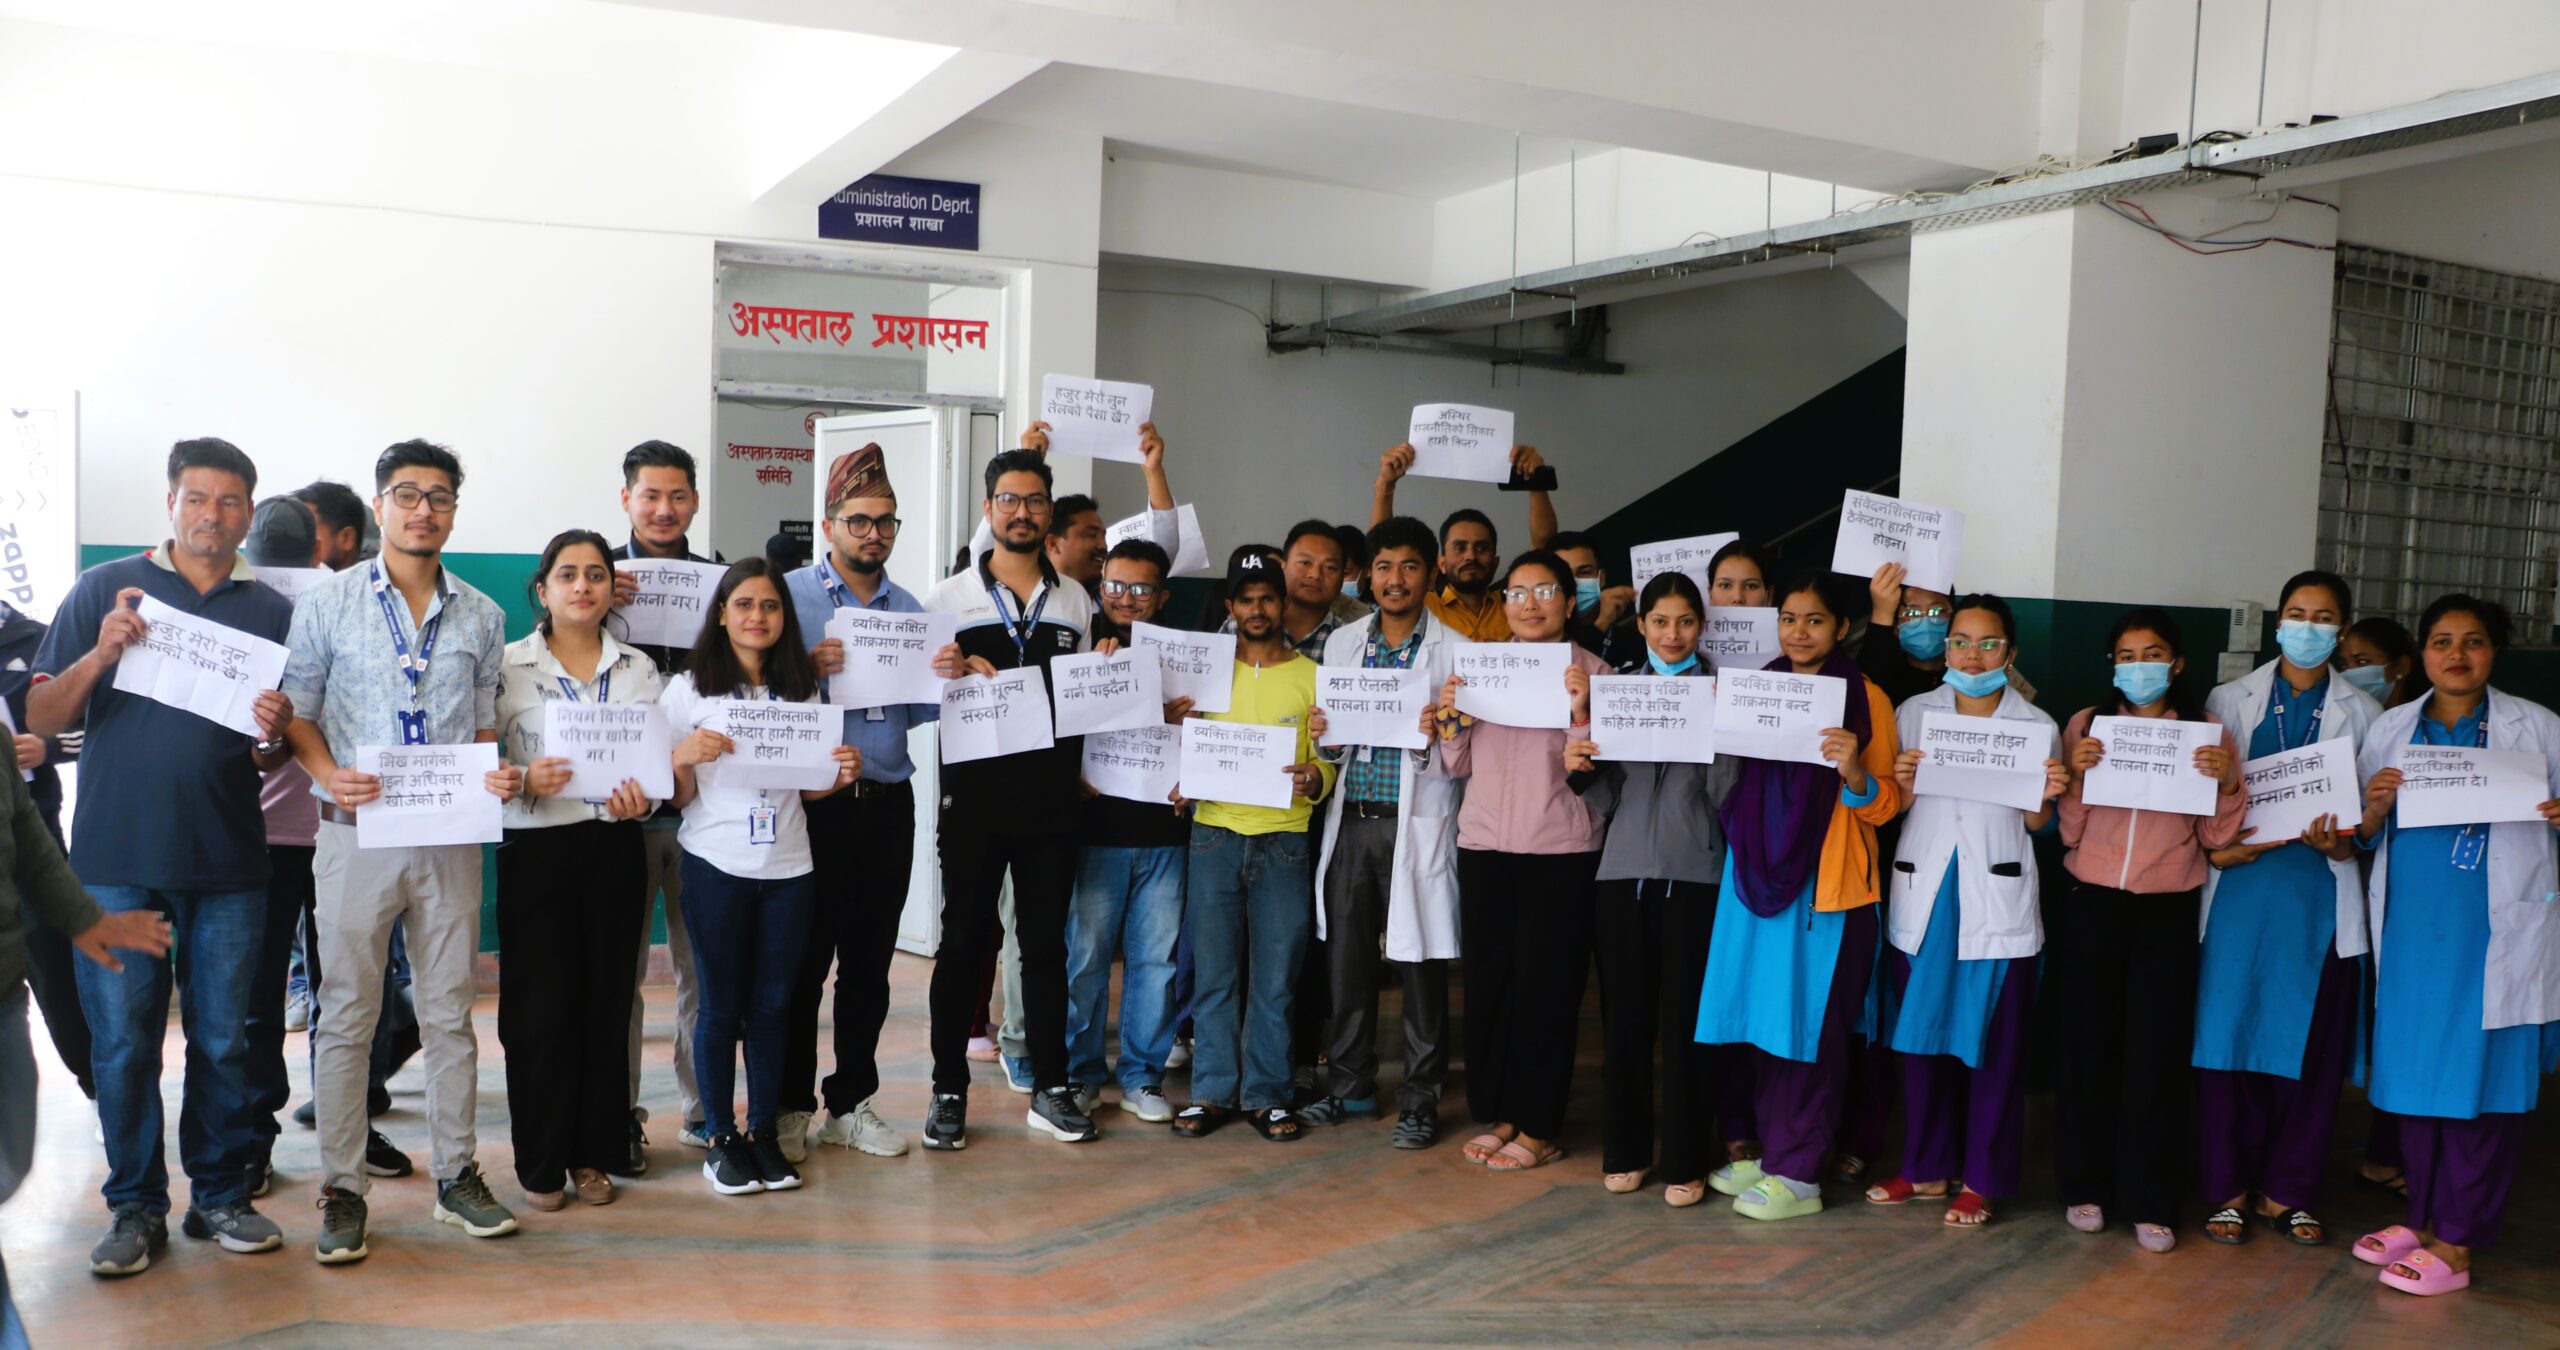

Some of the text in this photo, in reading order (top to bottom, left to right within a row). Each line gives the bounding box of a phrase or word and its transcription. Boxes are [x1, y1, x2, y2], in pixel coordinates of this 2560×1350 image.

[932, 194, 974, 217] Deprt.
[854, 212, 944, 233] प्रशासन शाखा
[728, 301, 989, 354] अस्पताल प्रशासन
[1055, 386, 1128, 410] हजुर मेरो नुन
[1047, 400, 1082, 417] तेलको
[1085, 405, 1107, 421] पैसा
[1427, 435, 1449, 447] हामी
[727, 443, 773, 463] अस्पताल
[756, 464, 793, 486] समिति
[1846, 509, 1941, 541] ठेकेदार हामी मात्र
[852, 616, 928, 634] व्यक्ति लक्षित
[1713, 616, 1754, 634] शोषण
[148, 618, 251, 665] हजुर मेरो नुन
[852, 635, 900, 649] आक्रमण
[1166, 640, 1187, 655] मेरो
[1189, 645, 1210, 661] नुन
[1705, 635, 1750, 657] पाइदैन
[188, 649, 219, 673] पैसा
[1069, 660, 1131, 680] श्रम शोषण
[1479, 653, 1498, 669] बेड
[1501, 653, 1520, 669] कि
[1063, 682, 1085, 700] गर्न
[1088, 678, 1129, 699] पाइदैन
[1328, 674, 1400, 692] श्रम ऐनको
[1482, 675, 1510, 688] ???
[1732, 675, 1815, 695] व्यक्ति लक्षित
[946, 679, 1025, 704] श्रमको मूल्य
[1325, 698, 1370, 712] पालना
[1607, 697, 1642, 713] कहिले
[1731, 694, 1782, 710] आक्रमण
[557, 706, 597, 723] नियम
[728, 704, 820, 724] संवेदनशिलताको
[1600, 714, 1637, 730] कहिले
[726, 723, 821, 742] ठेकेदार हामी मात्र
[1194, 725, 1268, 743] व्यक्ति लक्षित
[1926, 727, 2028, 751] आश्वासन होइन
[2156, 724, 2182, 740] सेवा
[1097, 736, 1129, 752] कहिले
[1194, 742, 1239, 756] आक्रमण
[2112, 737, 2179, 758] नियमावली
[412, 751, 457, 768] मागेको
[1090, 751, 1121, 767] कहिले
[1932, 748, 1987, 766] भुक्तानी
[2110, 758, 2149, 773] पालना
[2402, 760, 2475, 773] पदाधिकारी
[409, 771, 464, 788] अधिकार
[385, 790, 453, 807] खोजेको हो
